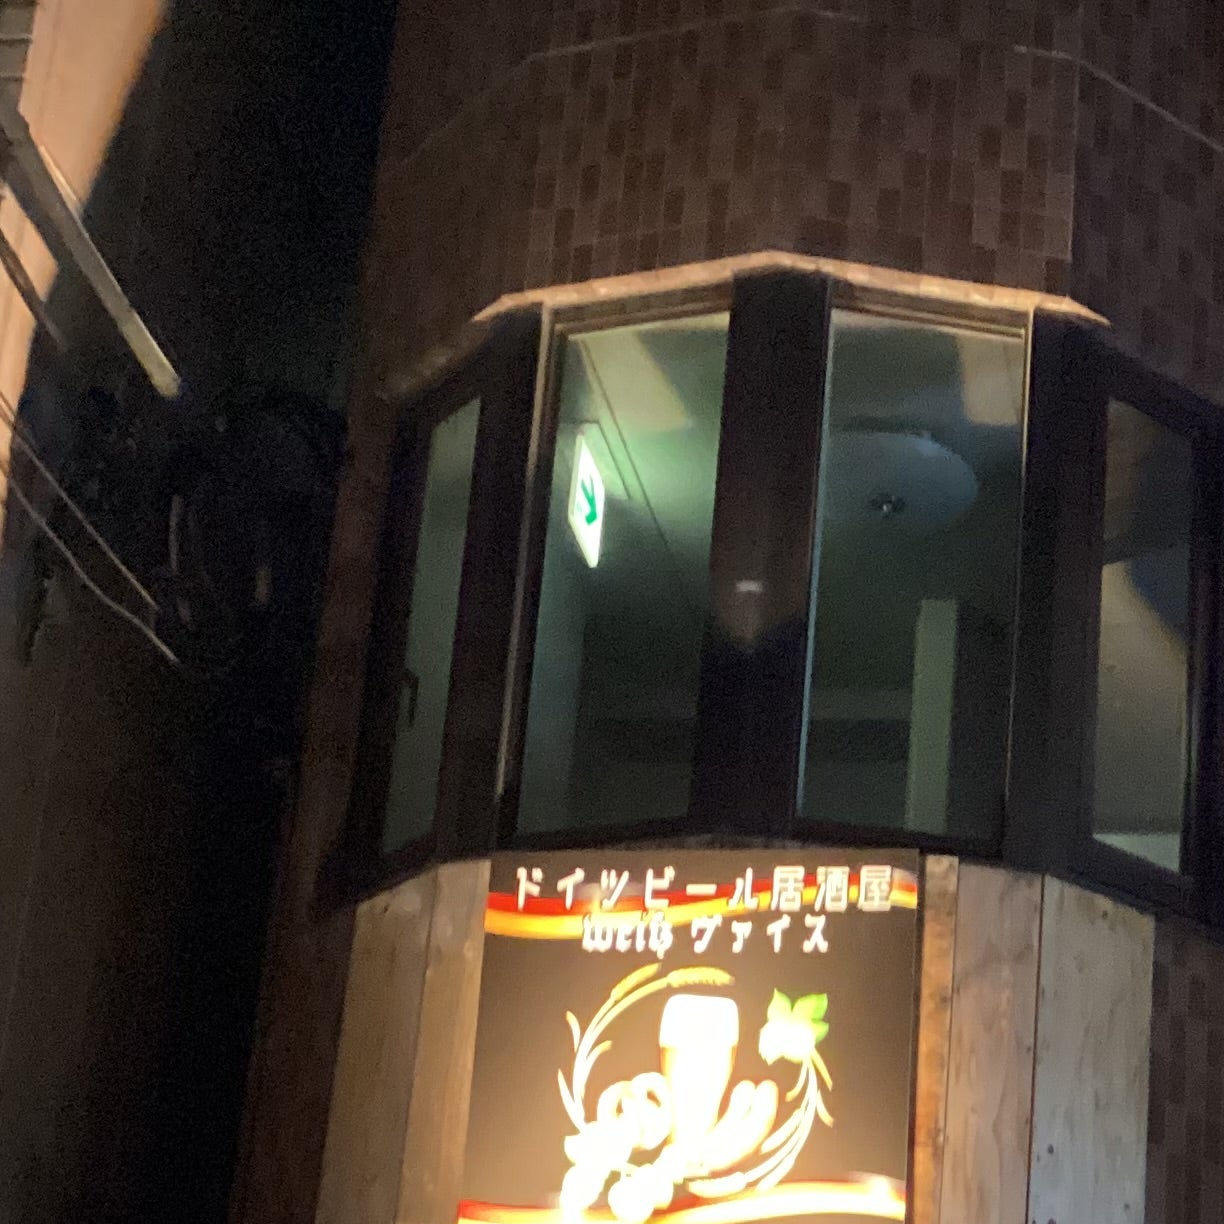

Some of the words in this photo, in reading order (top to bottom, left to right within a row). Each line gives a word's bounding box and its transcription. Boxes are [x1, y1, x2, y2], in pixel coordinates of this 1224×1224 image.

[516, 865, 893, 912] ドイツビール居酒屋
[691, 914, 829, 953] ヴァイス
